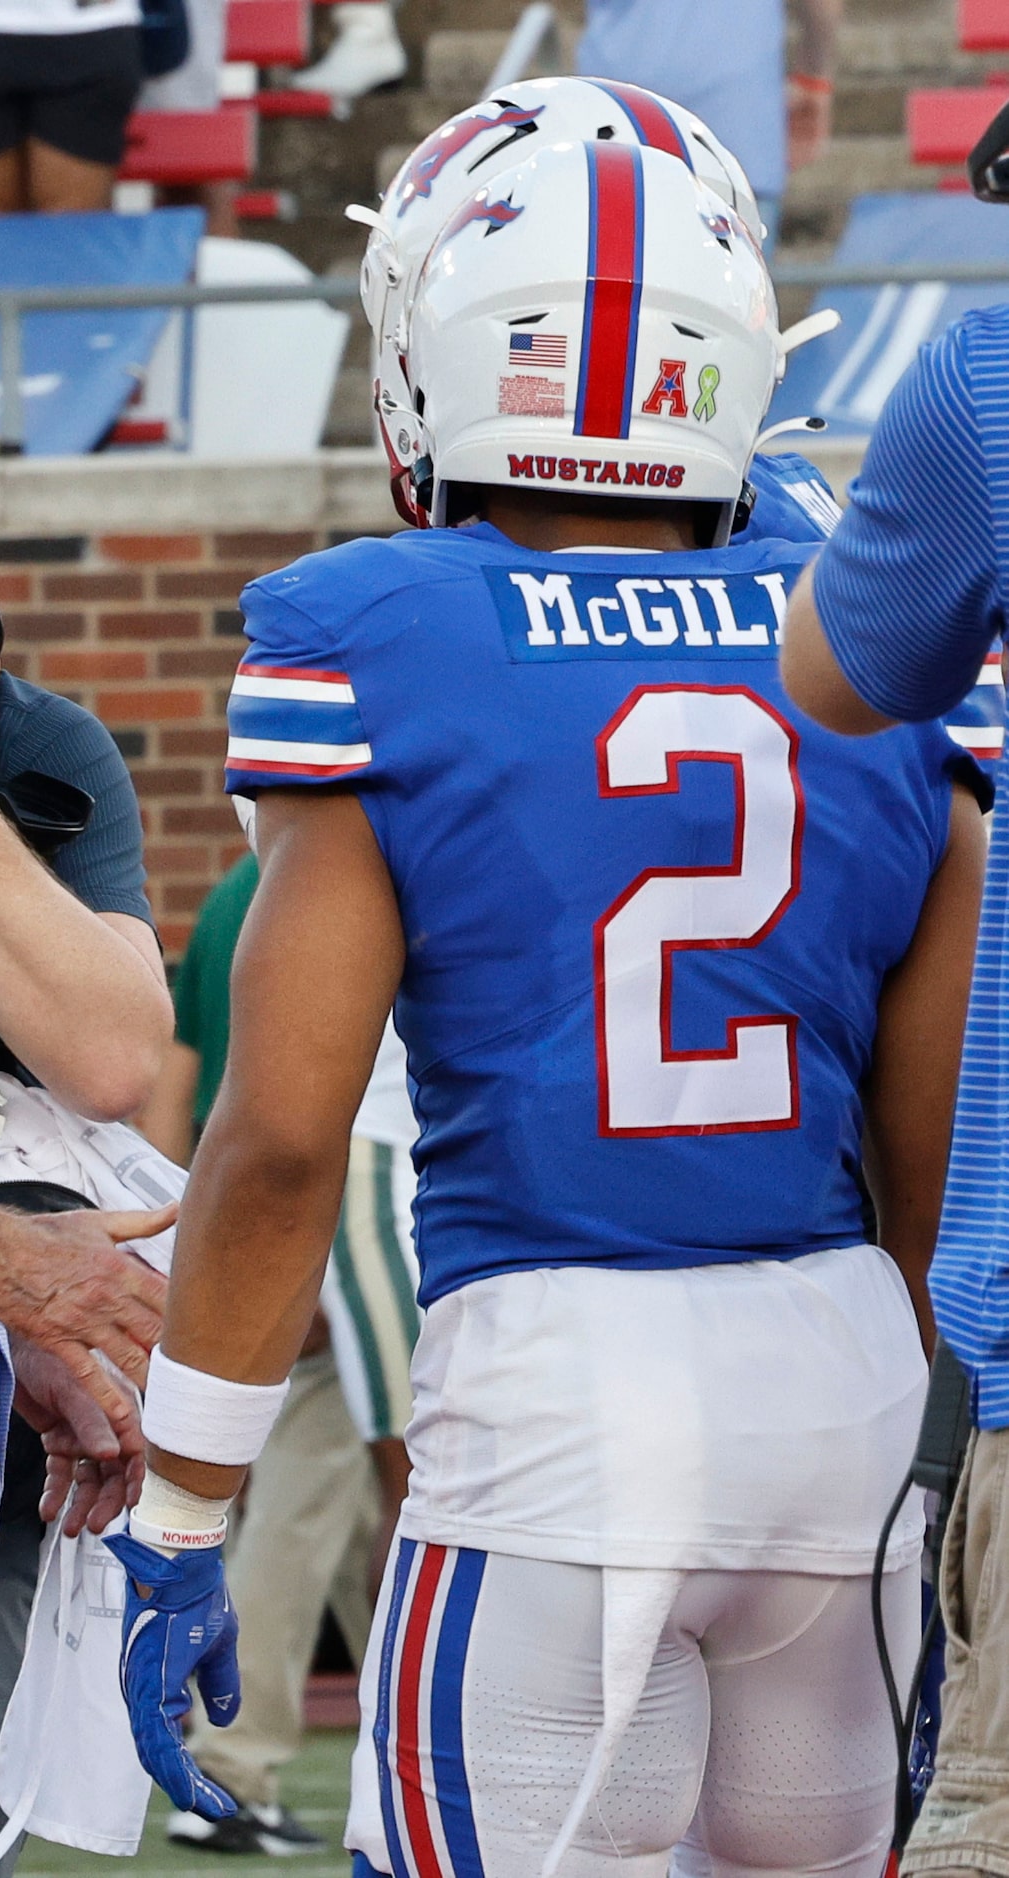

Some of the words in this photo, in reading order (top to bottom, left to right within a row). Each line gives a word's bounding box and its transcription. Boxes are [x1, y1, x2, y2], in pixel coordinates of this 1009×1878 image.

[642, 358, 688, 418] A
[507, 454, 686, 488] MUSTANGS
[592, 683, 806, 1138] 2
